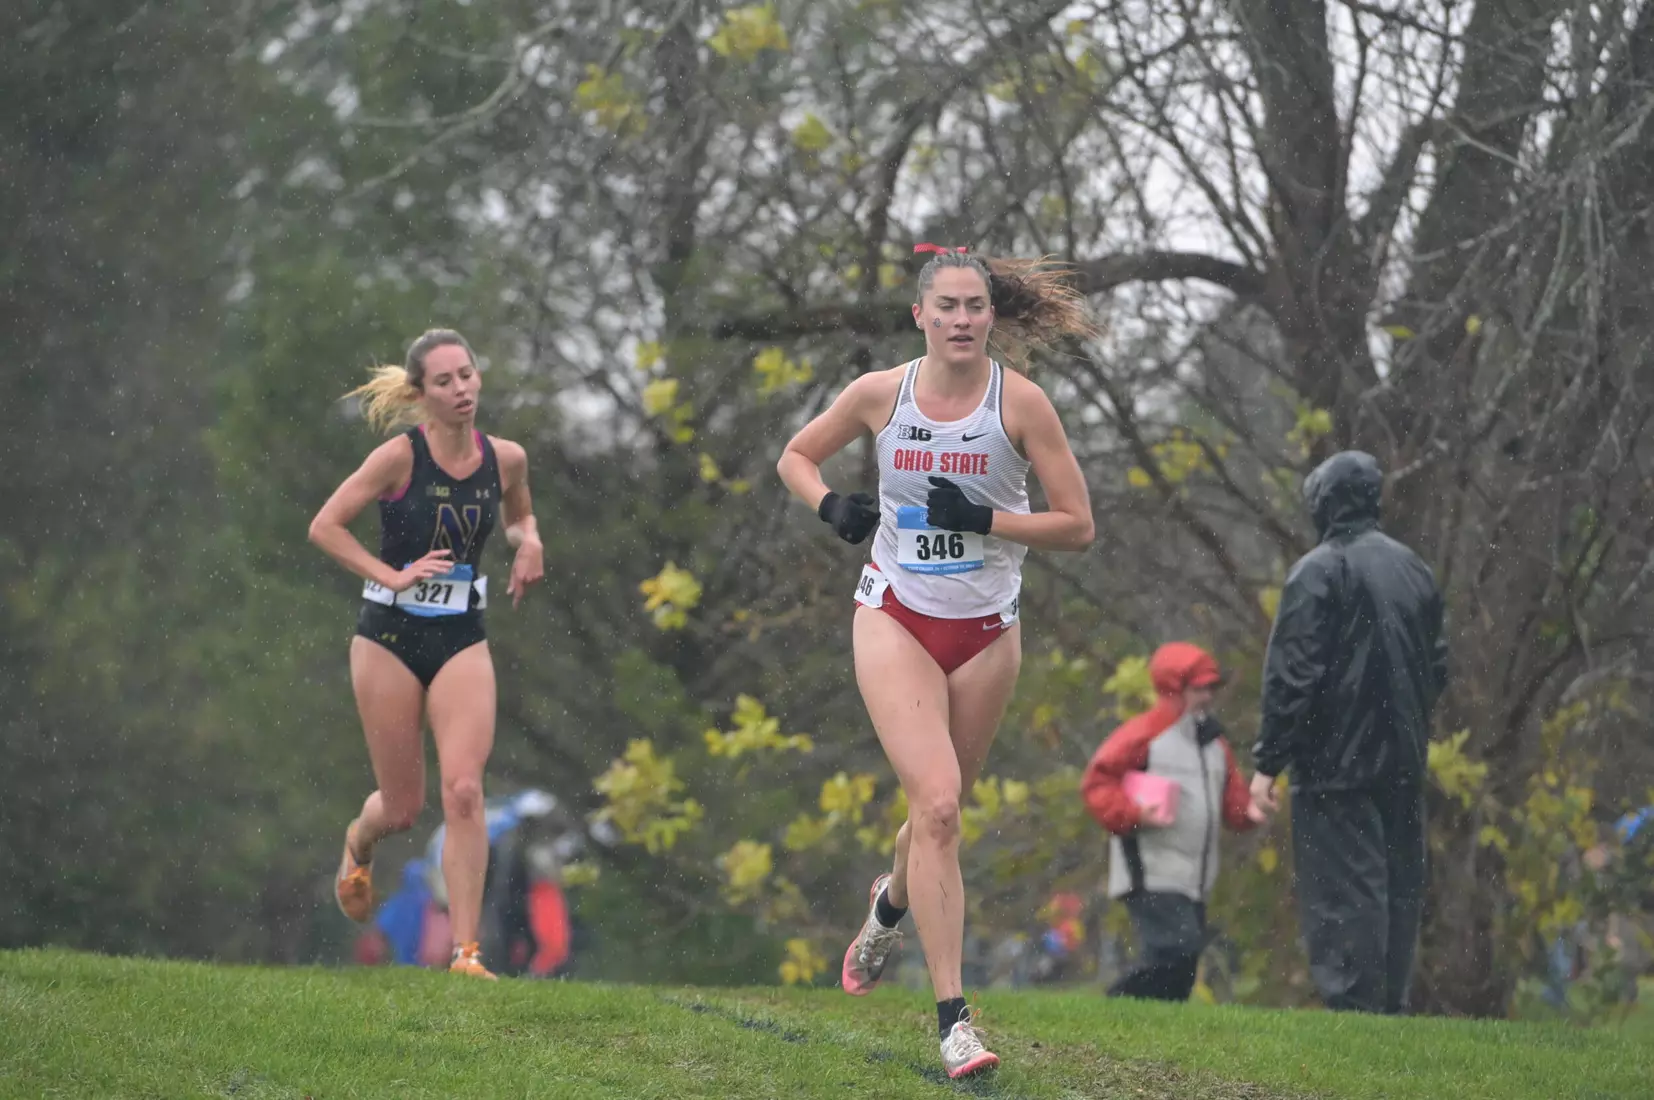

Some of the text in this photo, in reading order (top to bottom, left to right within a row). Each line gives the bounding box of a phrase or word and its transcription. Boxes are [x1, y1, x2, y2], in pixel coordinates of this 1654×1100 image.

[893, 448, 989, 475] OHIO STATE
[431, 503, 481, 562] N
[916, 533, 965, 561] 346
[414, 582, 454, 605] 327
